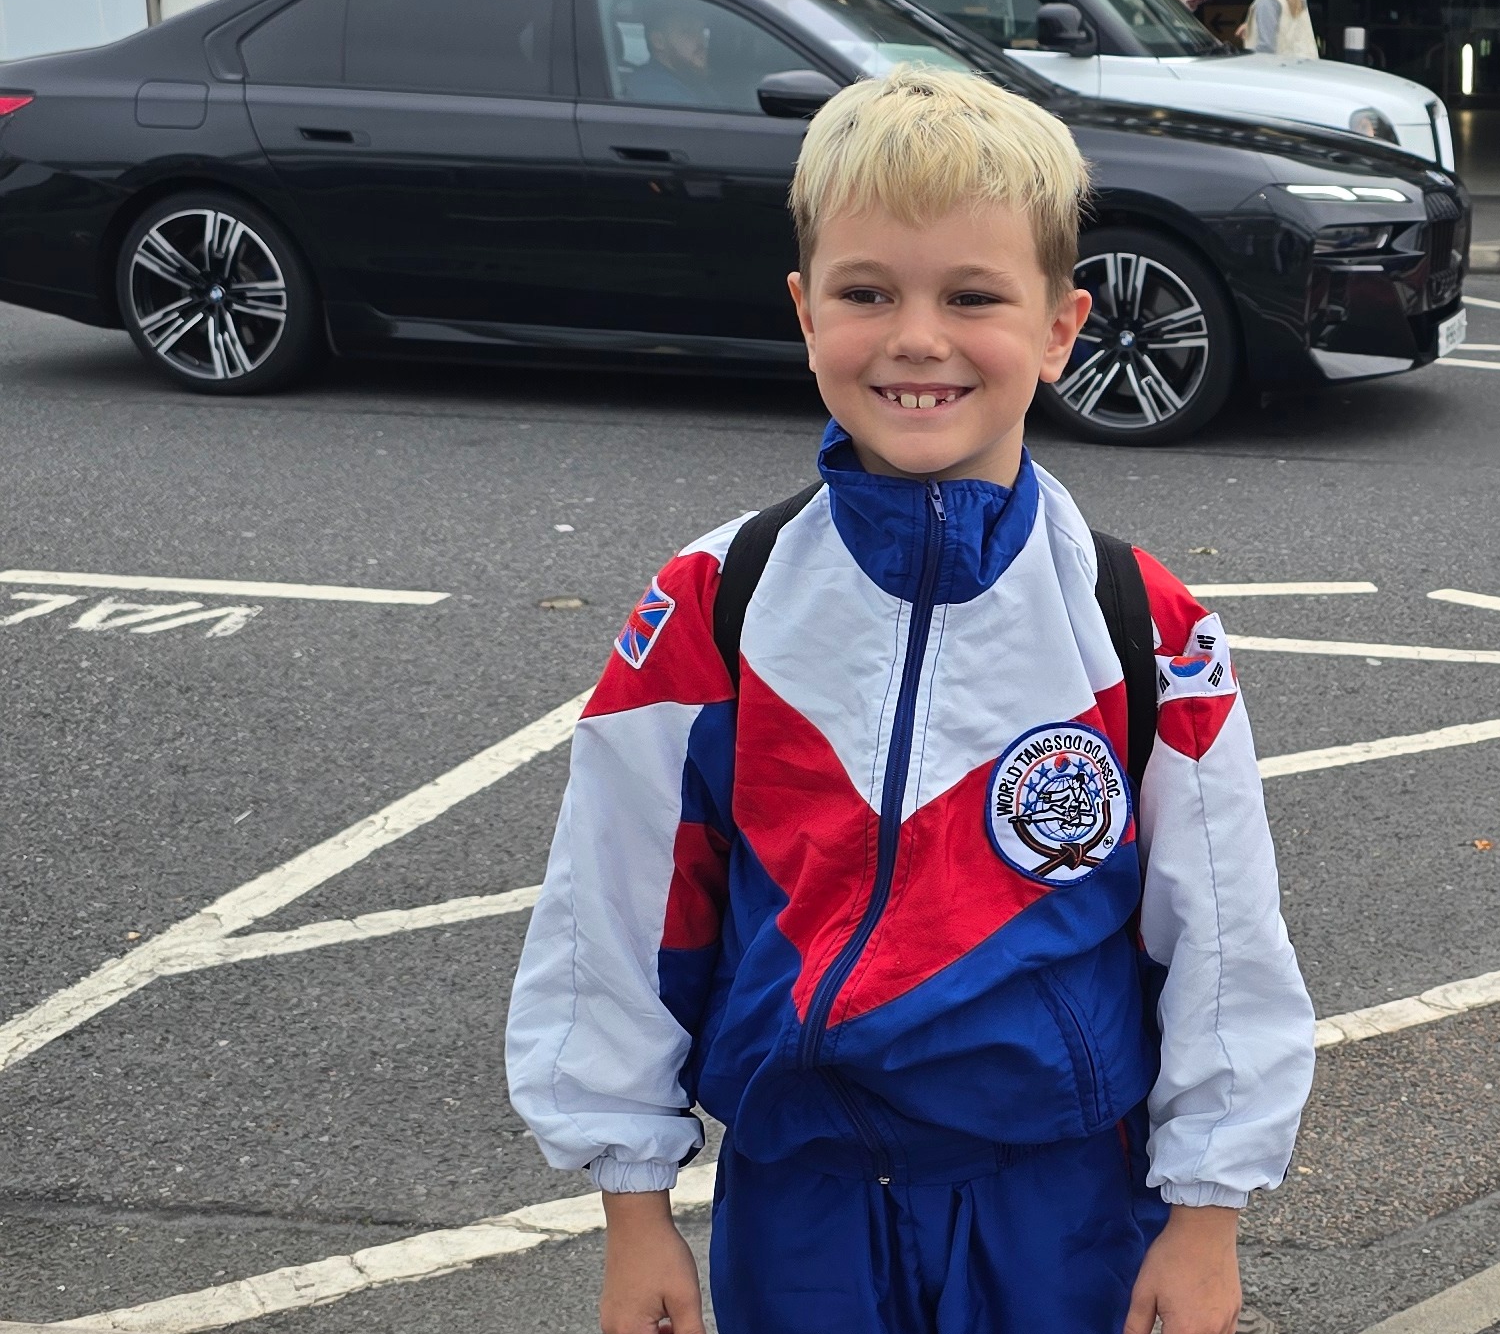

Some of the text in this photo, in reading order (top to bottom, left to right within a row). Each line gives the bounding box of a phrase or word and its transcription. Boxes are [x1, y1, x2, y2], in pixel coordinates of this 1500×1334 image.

[996, 765, 1024, 818] WORLD
[1083, 739, 1103, 760] DO
[1095, 754, 1121, 799] ASSOC
